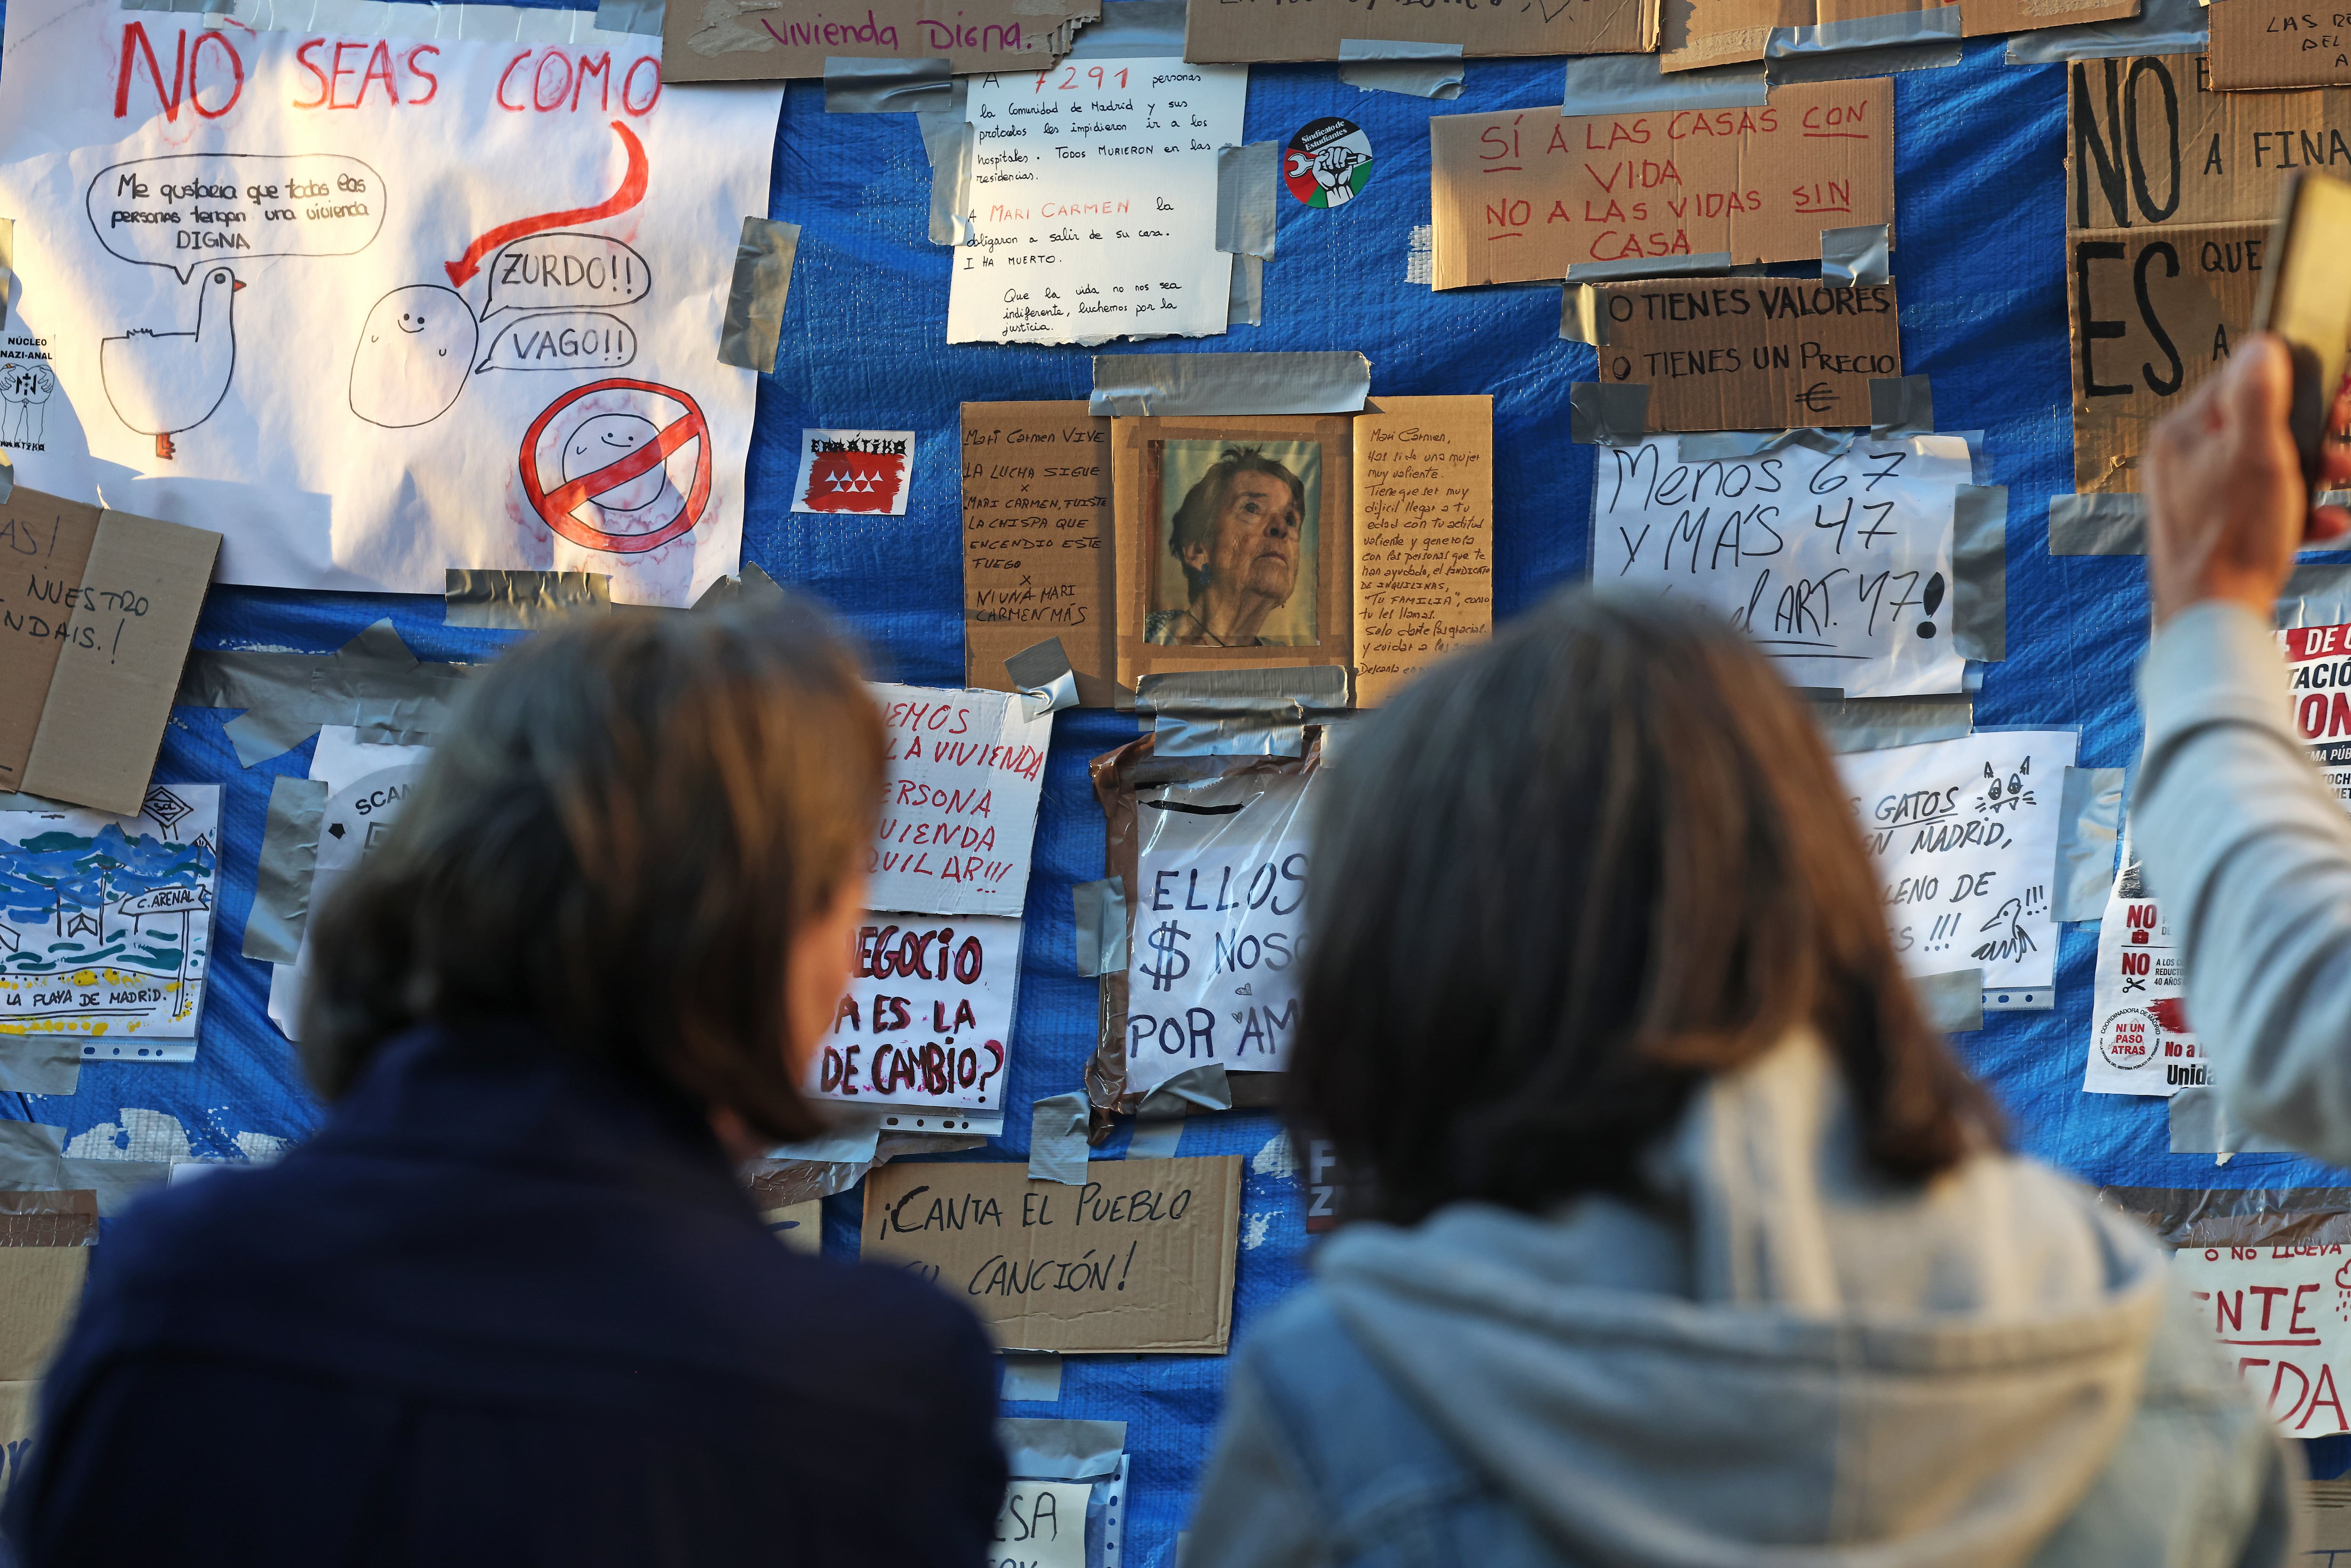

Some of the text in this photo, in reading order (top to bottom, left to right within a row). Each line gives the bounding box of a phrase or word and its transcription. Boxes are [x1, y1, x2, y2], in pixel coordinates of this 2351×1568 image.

[2266, 15, 2318, 32] LAS
[2302, 35, 2340, 51] DEL
[114, 21, 662, 123] NO SEAS COMO
[983, 66, 1201, 94] A 7291 personas
[980, 99, 1188, 119] la Comunidad de Madrid y sus
[1301, 120, 1345, 144] Sindicato de
[1305, 128, 1348, 151] Estudiantes
[1479, 100, 1869, 159] SÍ A LAS CASAS CON
[2073, 56, 2180, 229] NO
[2203, 133, 2223, 175] A
[118, 174, 148, 199] Me
[247, 183, 280, 206] que
[285, 179, 330, 198] todas
[337, 173, 366, 194] las
[976, 172, 1038, 183] residencias.
[1585, 160, 1683, 194] VIDA
[190, 205, 246, 226] tengan
[266, 205, 296, 221] una
[307, 200, 370, 221] vivienda
[968, 197, 1174, 222] A MARI CARMEN la
[1486, 180, 1851, 226] NO A LAS VIDAS SIN
[176, 230, 251, 250] DIGNA
[1589, 229, 1692, 260] CASA
[982, 256, 994, 268] HA
[1008, 254, 1062, 266] MUERTO.
[2201, 240, 2262, 273] QUE
[501, 252, 632, 295] ZURDO!!
[1004, 288, 1030, 303] Que
[1044, 287, 1061, 299] la
[1075, 284, 1100, 295] vida
[1160, 281, 1182, 291] sea
[1609, 286, 1891, 322] O TIENES VALORES
[2076, 241, 2184, 399] ES
[0, 350, 53, 360] NAZI-ANAL
[8, 337, 47, 346] NÚCLEO
[513, 328, 623, 362] VAGO!!
[2212, 323, 2231, 361] A
[1611, 356, 1632, 381] O
[1643, 348, 1741, 377] TIENES
[1753, 345, 1789, 370] UN
[1794, 381, 1839, 412] €
[966, 427, 1105, 445] Mari Carmen VIVE
[1370, 427, 1451, 444] Mari Carmen,
[963, 462, 1100, 479] LA LUCHA SIGUE
[1368, 466, 1444, 484] muy valiente.
[1609, 443, 1907, 513] Menos 67
[970, 536, 1102, 549] ENCENDIO ESTE
[1664, 504, 1783, 574] MÁS
[1815, 497, 1898, 554] 47
[972, 558, 1021, 569] FUEGO
[27, 574, 149, 617] NUESTRO
[1360, 581, 1449, 592] DE INQUILINAS,
[1775, 568, 1850, 637] ART.
[1860, 569, 1945, 640] 47!
[2305, 627, 2339, 655] DE
[934, 741, 1043, 782] VIVIENDA
[154, 802, 176, 812] SOL
[1875, 786, 1959, 823] GATOS
[1152, 853, 1309, 915] ELLOS
[1949, 872, 1996, 903] DE
[137, 890, 194, 909] C. ARENAL
[2126, 904, 2157, 929] NO
[1139, 920, 1191, 992] $
[2121, 952, 2150, 976] NO
[2164, 977, 2181, 985] AÑOS
[6, 993, 22, 1006] LA
[33, 989, 72, 1007] PLAYA
[79, 993, 100, 1007] DE
[873, 994, 911, 1033] ES
[934, 999, 976, 1034] LA
[2101, 1008, 2139, 1034] COORDINADORA
[2147, 1014, 2161, 1035] MADRID
[1127, 1007, 1215, 1058] POR
[2116, 1034, 2143, 1043] PASO
[2130, 1024, 2145, 1032] UN
[2111, 1046, 2146, 1055] ATRAS
[2165, 1041, 2182, 1057] No
[2186, 1044, 2195, 1057] a
[820, 1045, 860, 1095] DE
[1023, 1193, 1053, 1228] EL
[2205, 1248, 2219, 1261] O
[2231, 1246, 2256, 1261] NO
[968, 1240, 1137, 1296] CANCIÓN!
